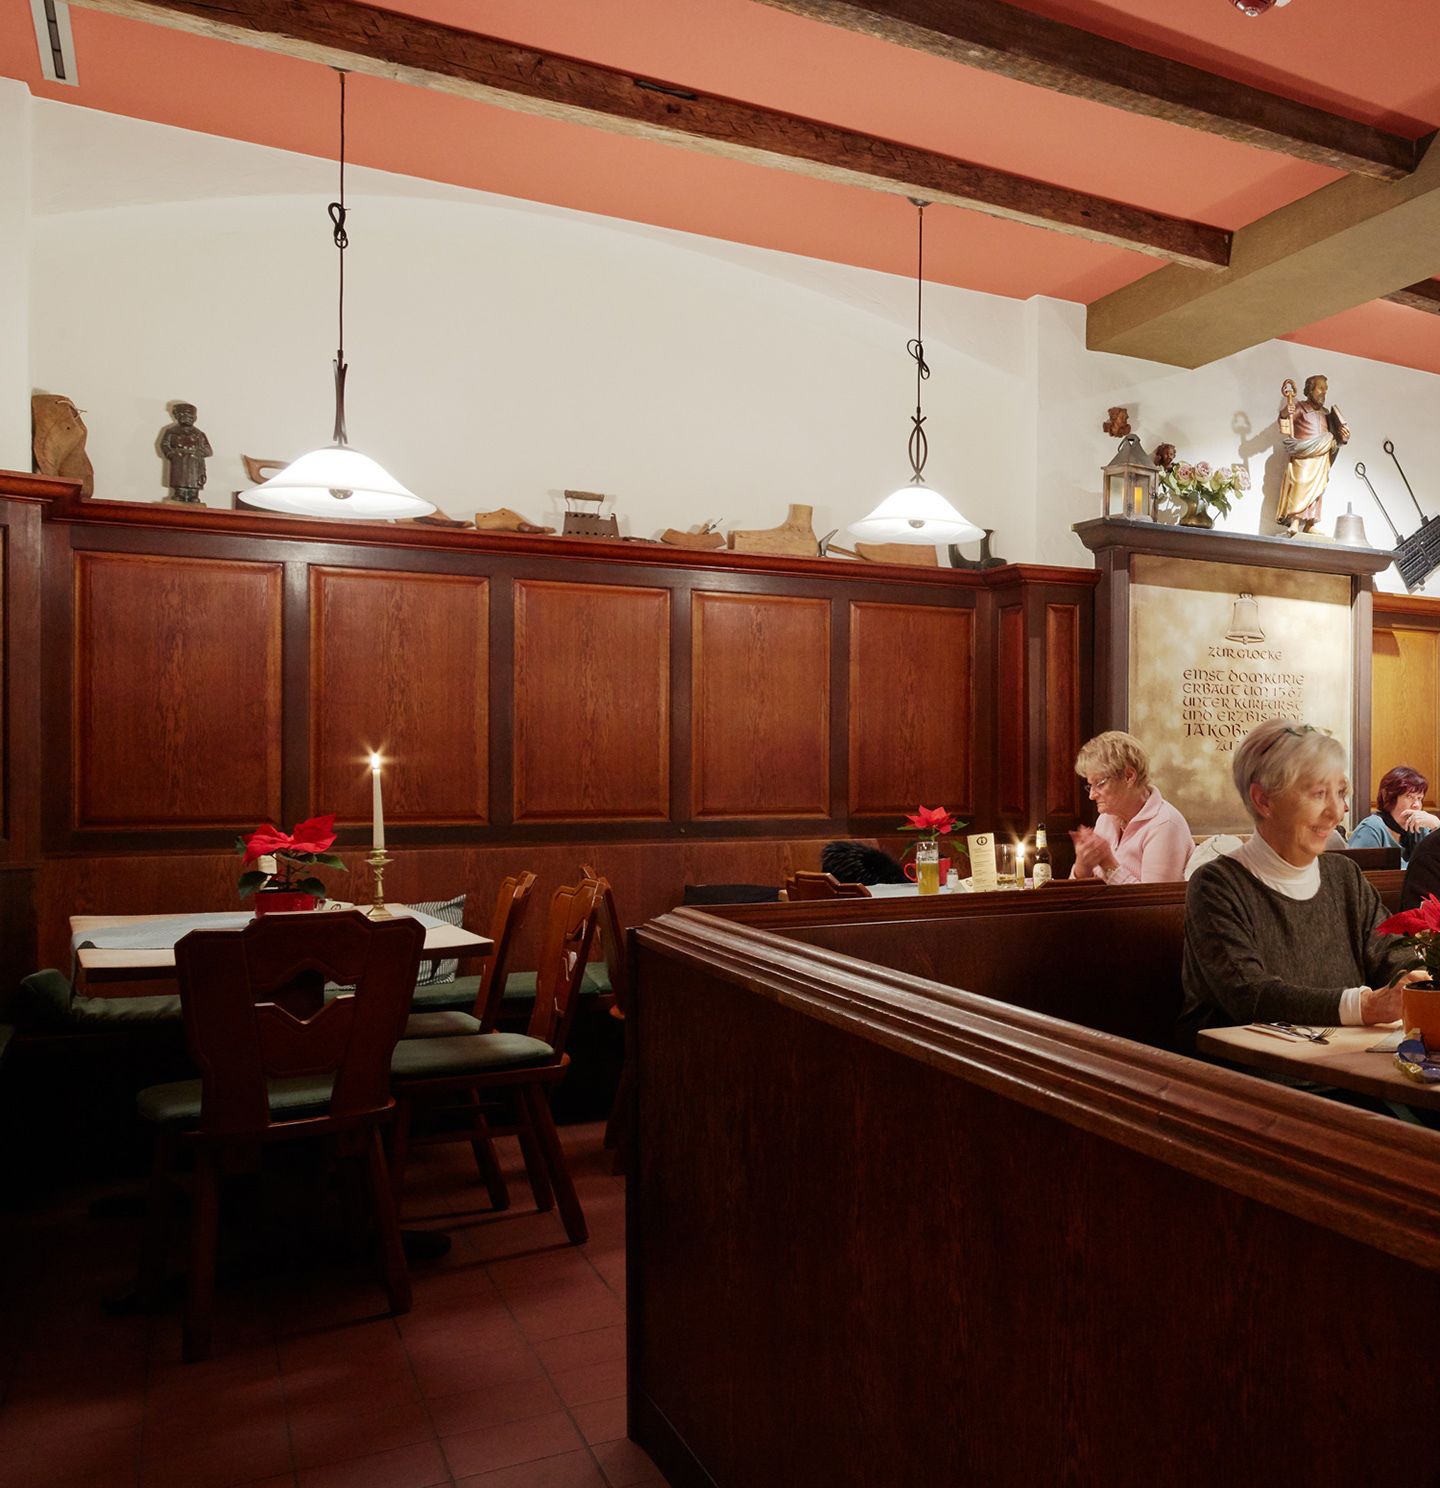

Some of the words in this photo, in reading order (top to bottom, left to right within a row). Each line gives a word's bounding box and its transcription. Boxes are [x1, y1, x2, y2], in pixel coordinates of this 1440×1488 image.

[1207, 646, 1236, 659] ZUR
[1237, 648, 1283, 661] GLOCKE
[1183, 669, 1225, 682] EINST
[1182, 682, 1240, 696] ERBAUT
[1244, 685, 1269, 698] UM
[1182, 695, 1231, 709] UNTER
[1182, 708, 1213, 722] UND
[1184, 723, 1241, 738] JAKOB
